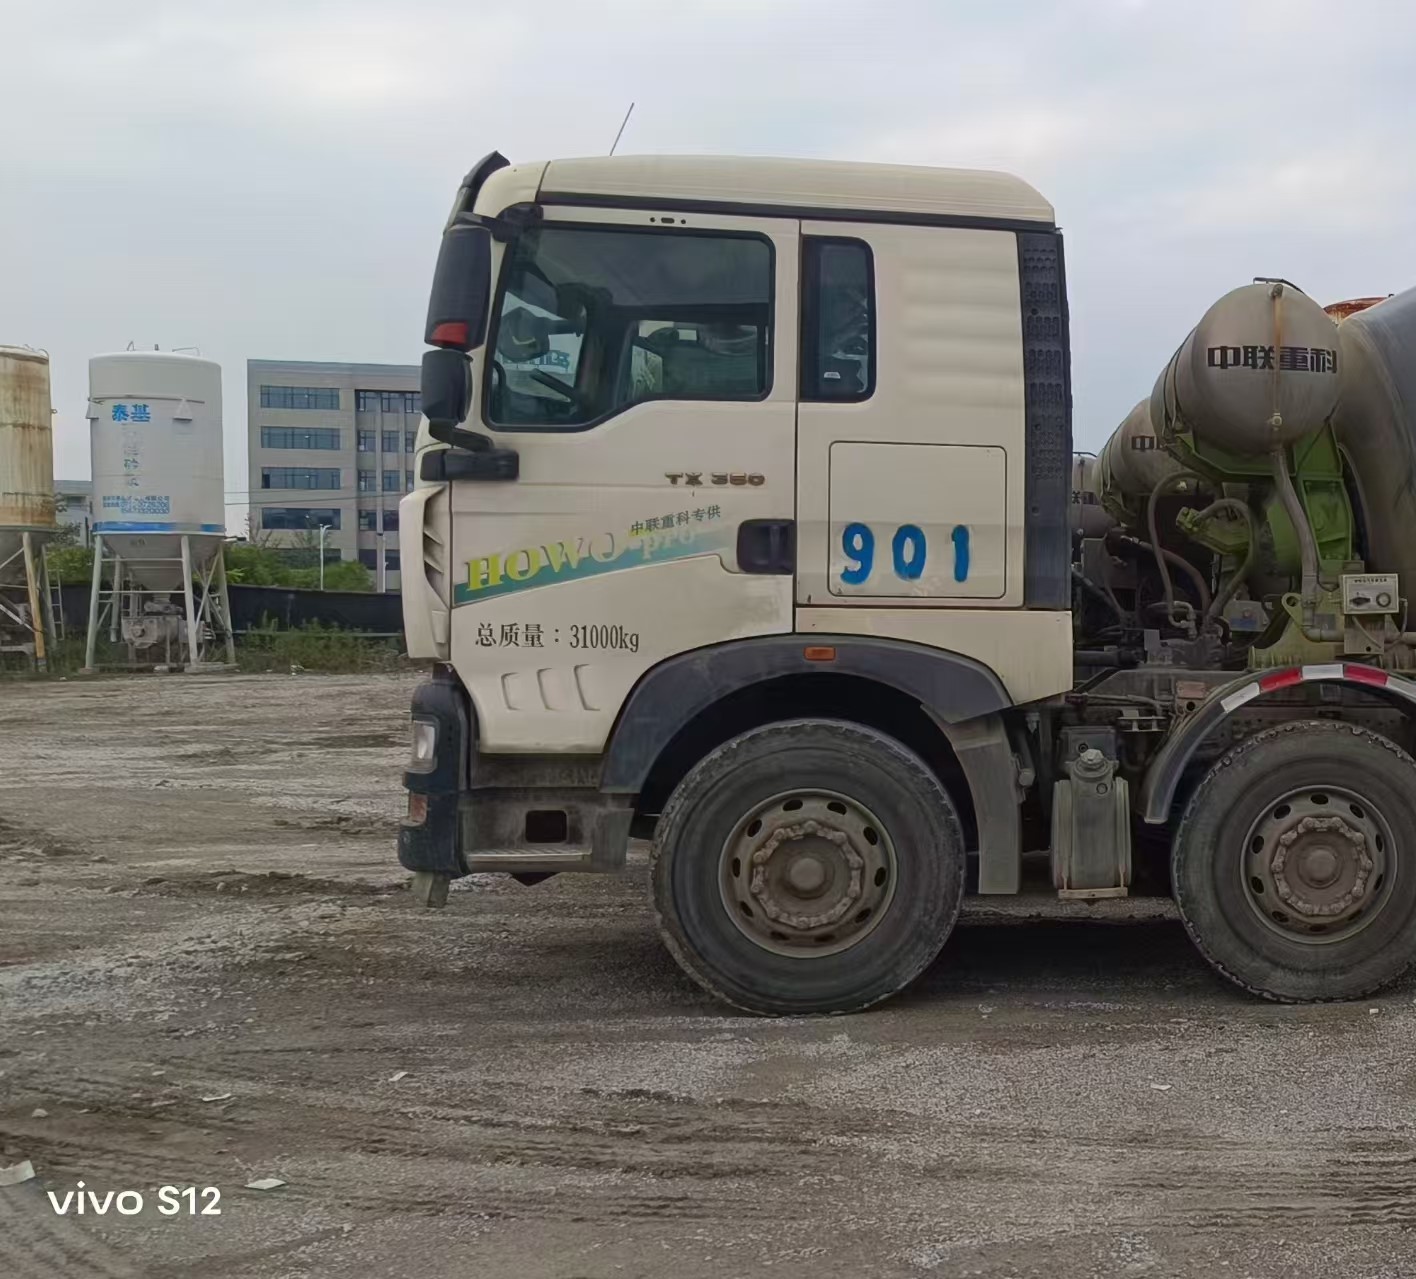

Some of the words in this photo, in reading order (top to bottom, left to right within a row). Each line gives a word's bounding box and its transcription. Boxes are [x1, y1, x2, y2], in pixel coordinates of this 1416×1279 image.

[1207, 345, 1338, 374] 中联重科
[112, 403, 151, 423] 泰基
[665, 472, 703, 486] TX
[631, 504, 722, 537] 中联重科专供
[840, 522, 971, 585] 901
